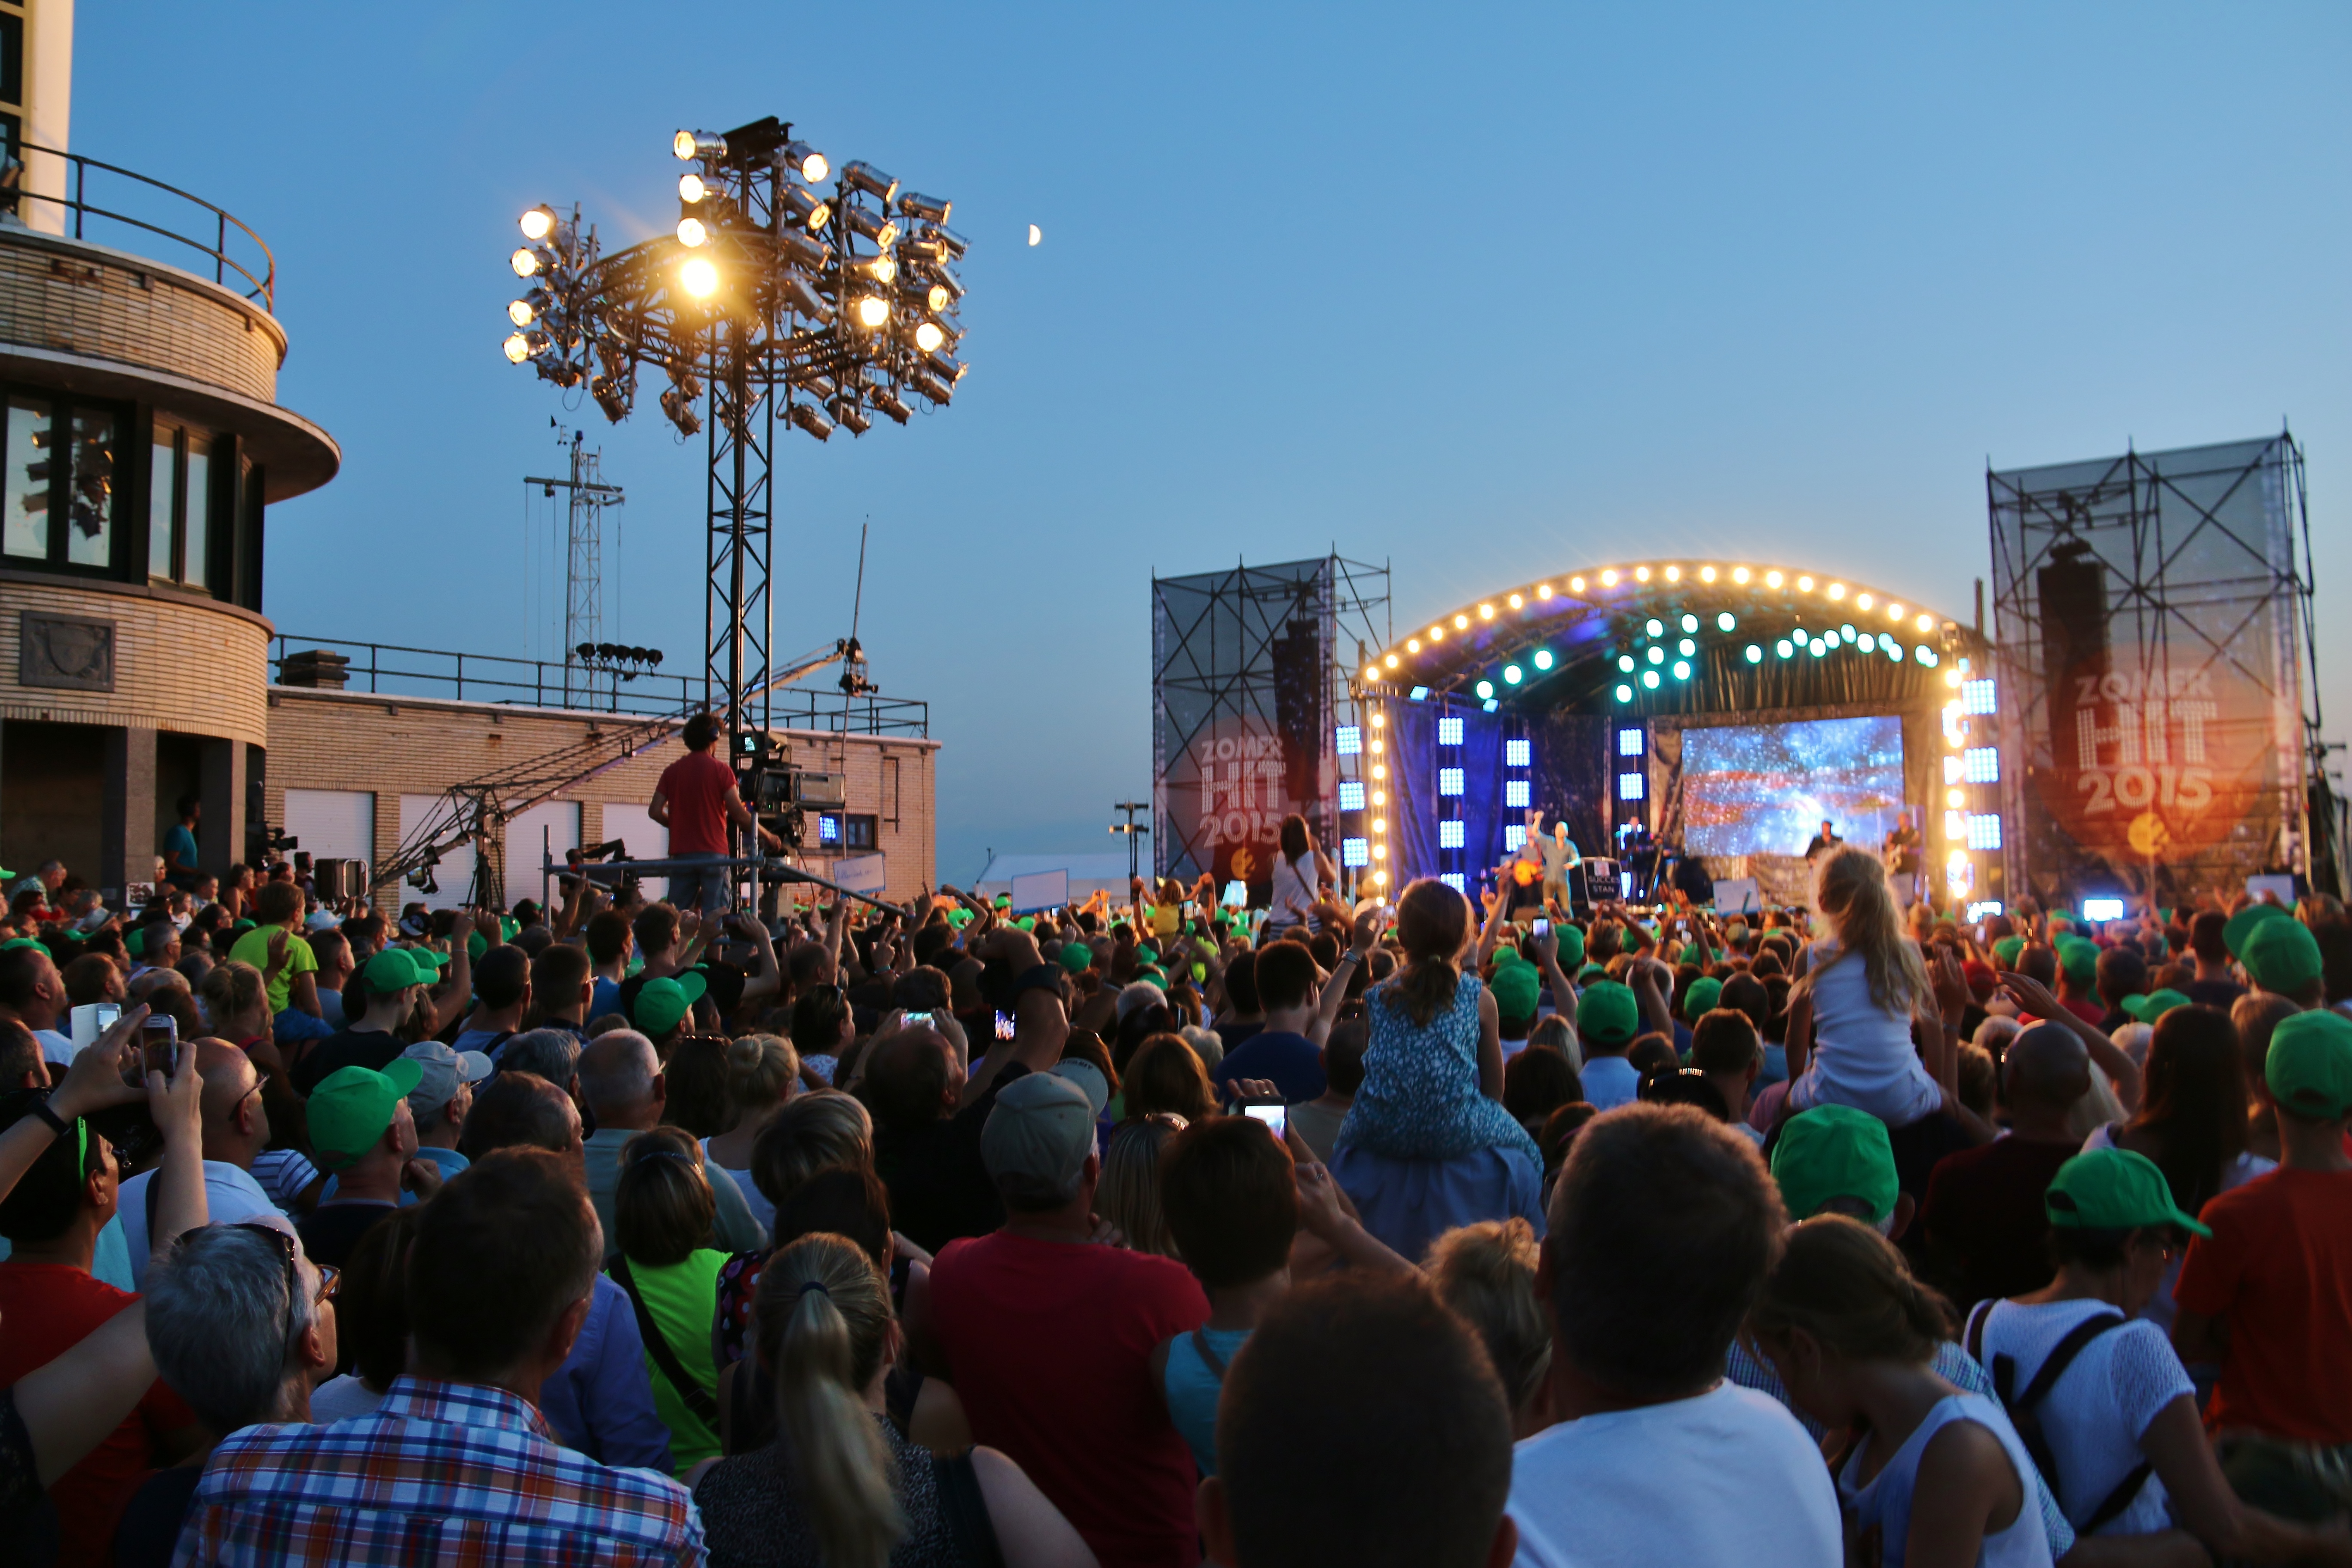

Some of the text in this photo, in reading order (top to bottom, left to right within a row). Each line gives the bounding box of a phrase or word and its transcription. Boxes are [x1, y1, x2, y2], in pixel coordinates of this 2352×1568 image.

[2075, 668, 2214, 705] ZOMER
[1201, 735, 1283, 763] ZOMER
[2076, 701, 2217, 771] HIT
[1201, 761, 1286, 815] HIT
[2077, 765, 2213, 815] 2015
[1199, 812, 1282, 848] 2015
